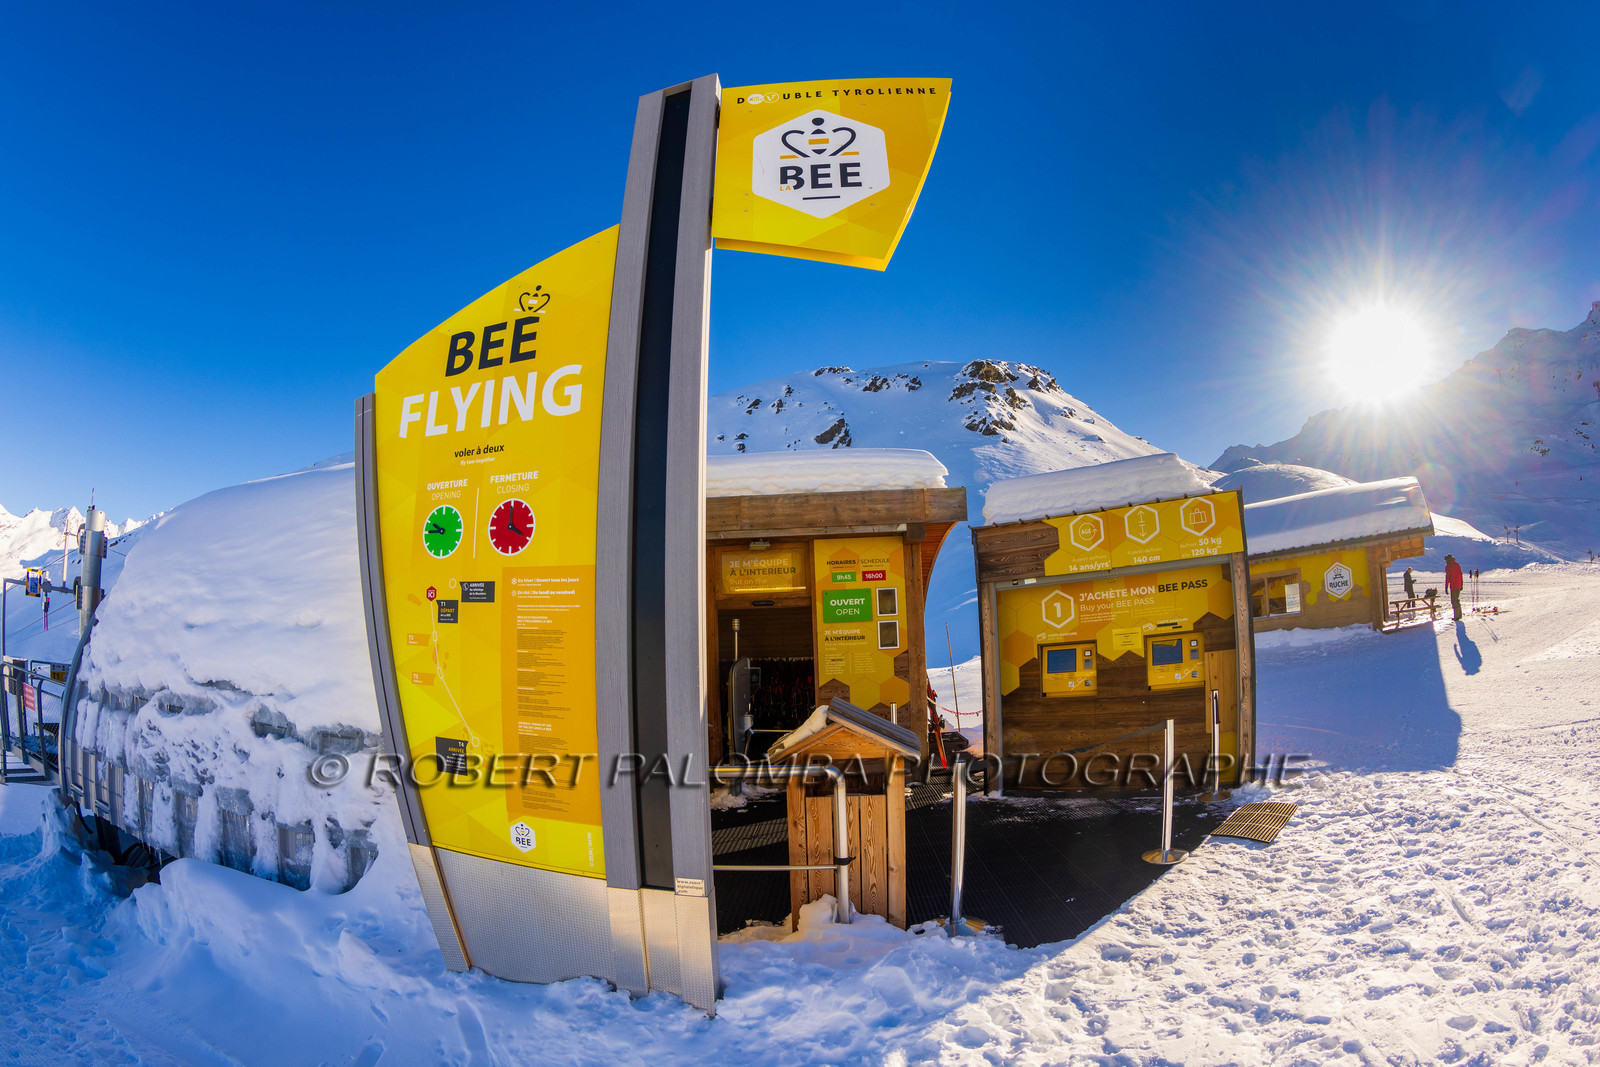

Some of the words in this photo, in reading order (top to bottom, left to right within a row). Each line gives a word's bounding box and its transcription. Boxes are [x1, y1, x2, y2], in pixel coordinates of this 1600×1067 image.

[832, 87, 936, 96] TYROLIENNE
[780, 162, 863, 190] BEE
[445, 316, 540, 377] BEE
[399, 364, 582, 438] FLYING
[454, 448, 475, 458] voler
[476, 446, 482, 455] à
[483, 444, 504, 454] deux
[490, 471, 539, 483] FERMETURE
[427, 479, 468, 490] OUVERTURE
[496, 483, 530, 494] CLOSING
[432, 490, 461, 500] OPENING
[1211, 537, 1222, 545] kg
[743, 558, 788, 568] M'ÉQUIPE
[730, 568, 736, 576] À
[740, 567, 796, 576] L'INTÉRIEUR
[1329, 580, 1348, 588] RUCHE
[1079, 589, 1127, 602] J'ACHÈTE
[1130, 586, 1155, 595] MON
[1158, 582, 1178, 593] BEE
[1181, 579, 1208, 590] PASS
[830, 598, 865, 606] OUVERT
[1080, 604, 1095, 612] Buy
[1097, 602, 1114, 611] your
[1134, 597, 1154, 606] PASS
[1054, 602, 1061, 618] 1
[516, 836, 532, 846] BEE
